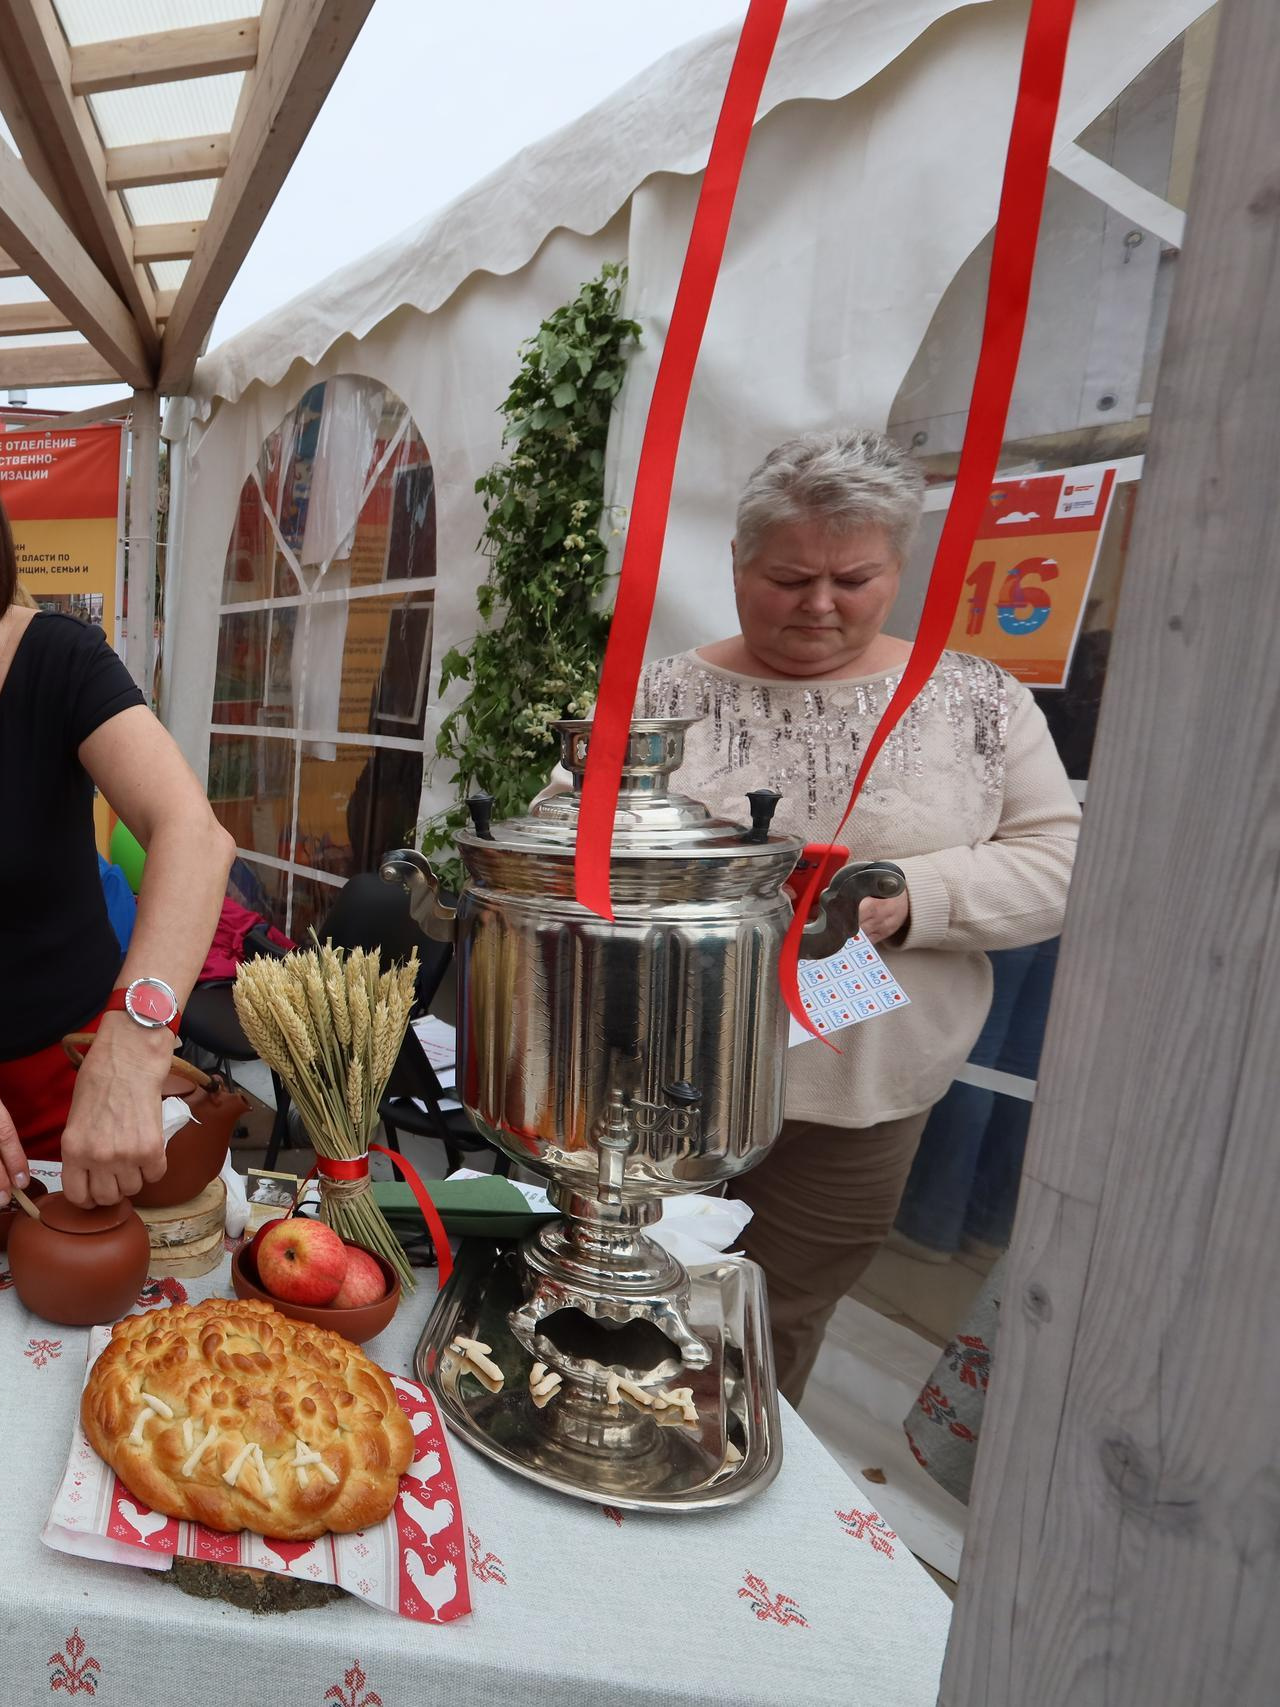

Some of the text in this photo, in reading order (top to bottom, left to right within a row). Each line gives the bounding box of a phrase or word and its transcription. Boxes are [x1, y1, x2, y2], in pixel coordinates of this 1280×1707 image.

[5, 438, 77, 450] ОТДЕЛЕНИЕ
[22, 554, 55, 562] ВЛАСТИ
[966, 556, 1059, 635] 16
